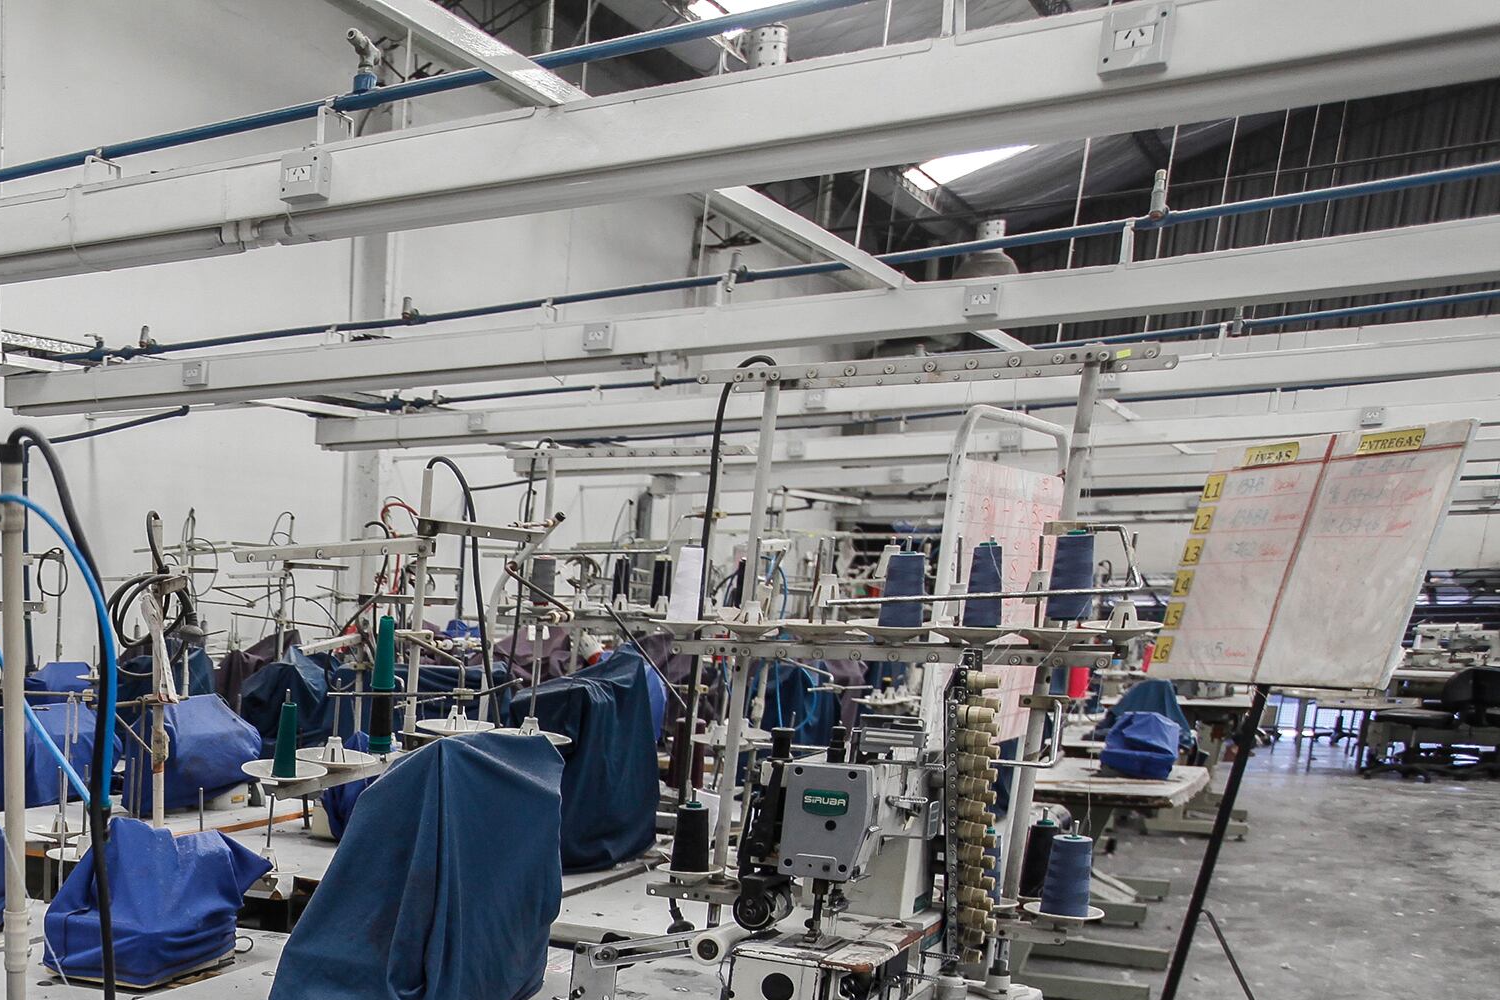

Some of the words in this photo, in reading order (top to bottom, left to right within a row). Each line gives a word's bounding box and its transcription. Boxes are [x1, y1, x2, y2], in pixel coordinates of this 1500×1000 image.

[1360, 435, 1422, 450] ENTREGAS
[1204, 482, 1221, 499] L1
[1194, 514, 1212, 531] L2
[1184, 546, 1201, 562] L3
[1174, 577, 1191, 593] L4
[1165, 609, 1181, 626] L5
[1153, 642, 1169, 659] L6
